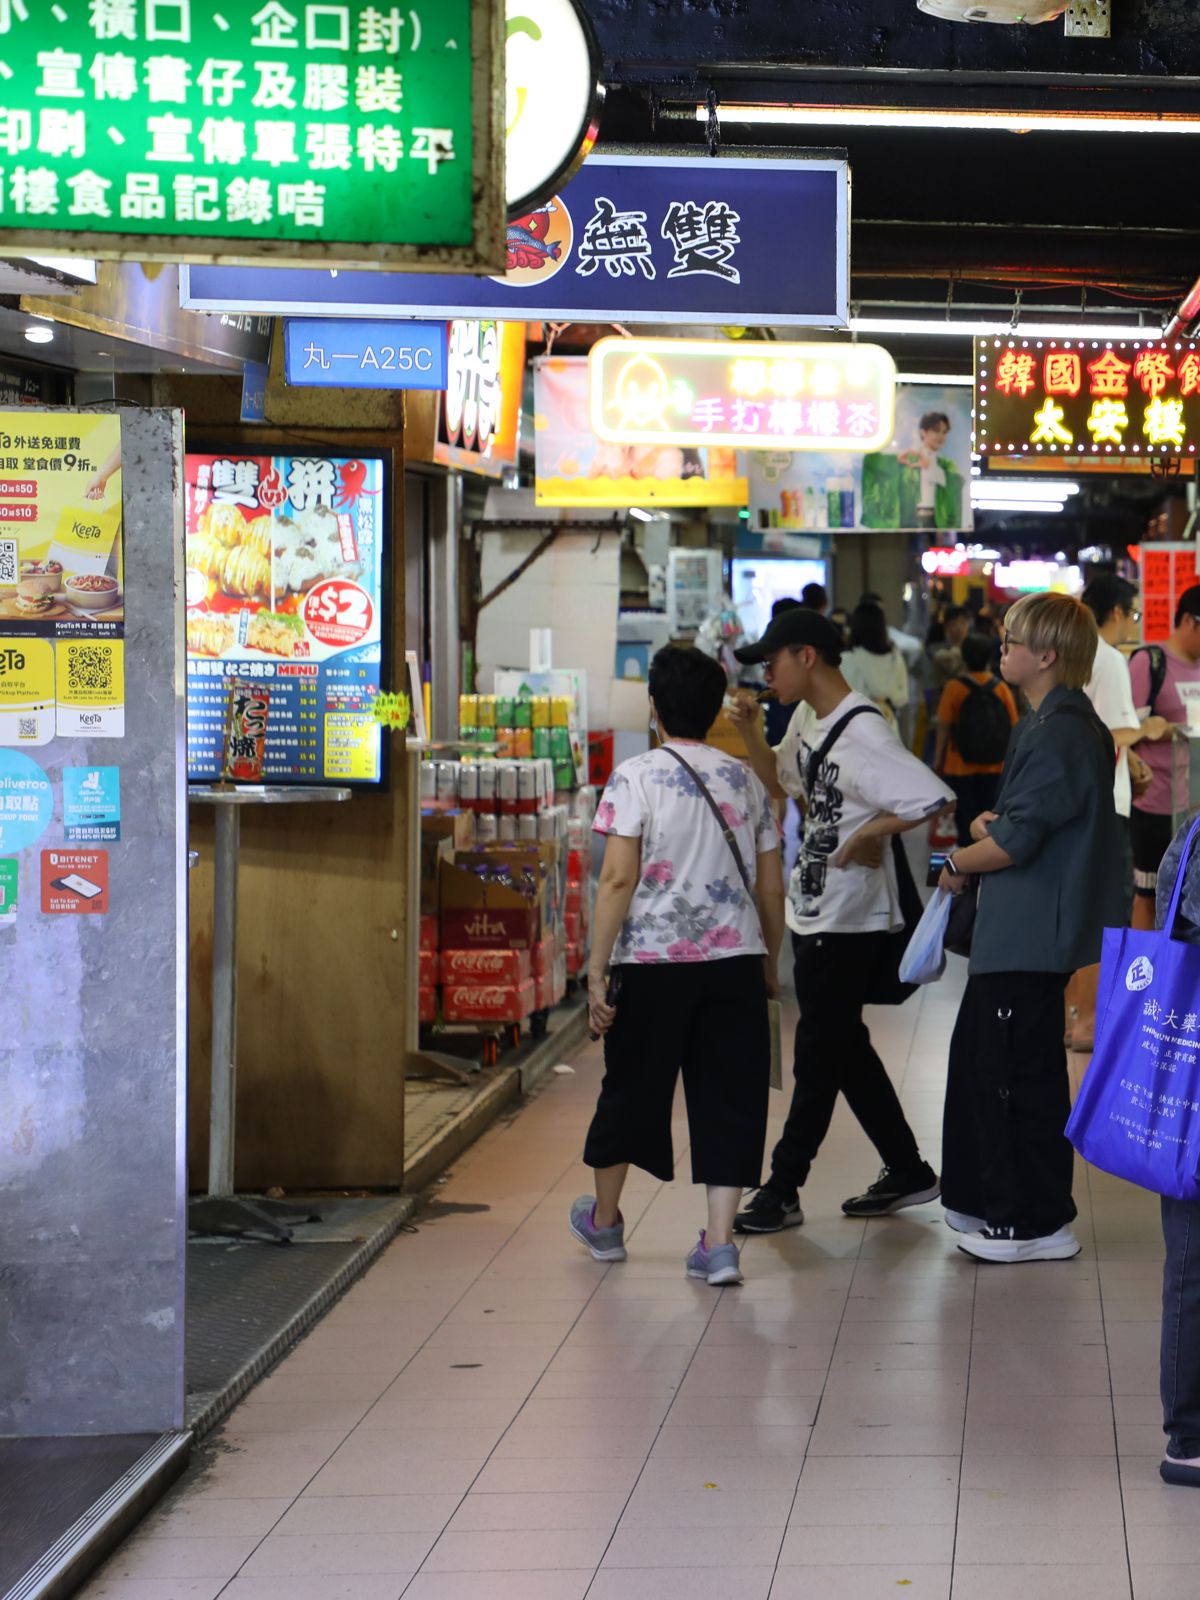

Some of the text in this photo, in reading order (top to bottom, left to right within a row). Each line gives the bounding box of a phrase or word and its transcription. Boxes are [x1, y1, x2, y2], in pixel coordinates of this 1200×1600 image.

[0, 166, 326, 228] 樓食品記錄咭
[576, 197, 741, 285] 無雙
[303, 341, 432, 372] 丸一A25C
[1030, 397, 1187, 444] 太安樓
[14, 435, 80, 450] 外送免運費
[212, 460, 260, 508] 雙
[288, 460, 337, 511] 拼
[72, 522, 101, 539] KeeTa
[318, 586, 369, 629] $2
[278, 664, 318, 676] MENU
[79, 714, 102, 725] KeeTa
[464, 913, 506, 935] vita
